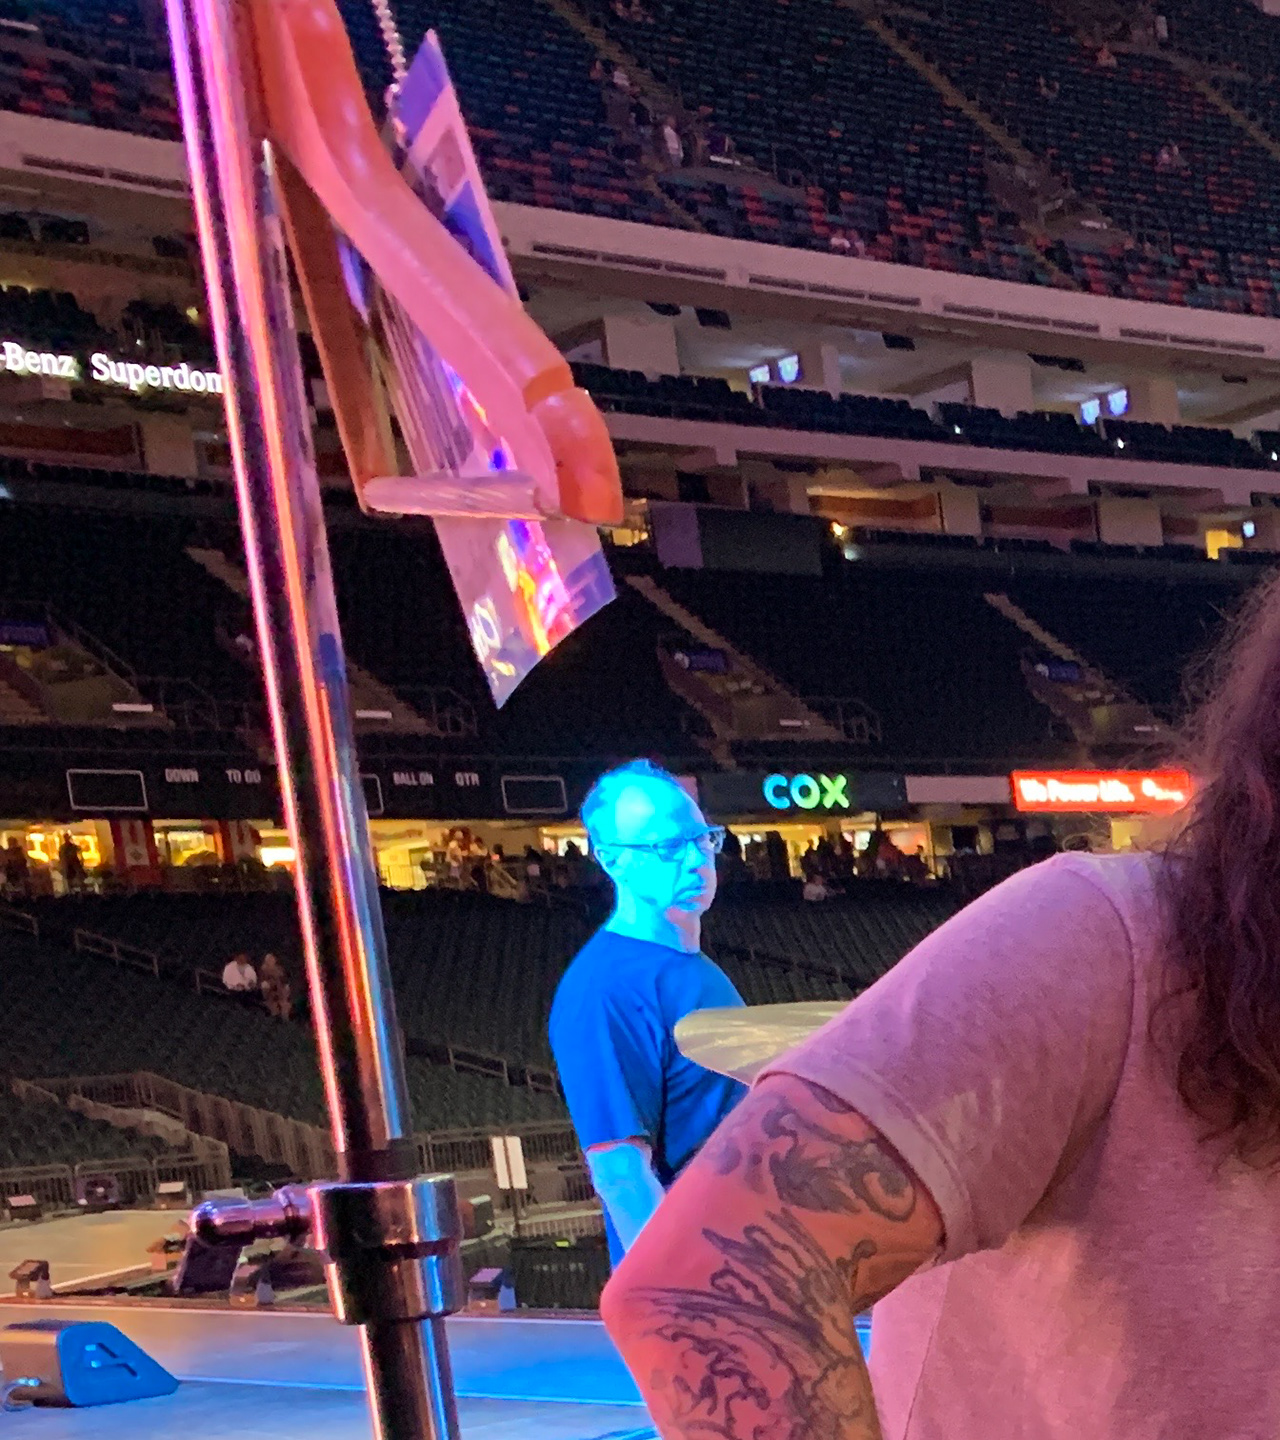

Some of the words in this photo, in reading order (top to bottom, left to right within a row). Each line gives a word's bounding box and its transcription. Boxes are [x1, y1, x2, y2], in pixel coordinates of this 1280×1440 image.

[165, 768, 199, 783] DOWN
[226, 769, 242, 783] TO
[763, 774, 849, 809] COX
